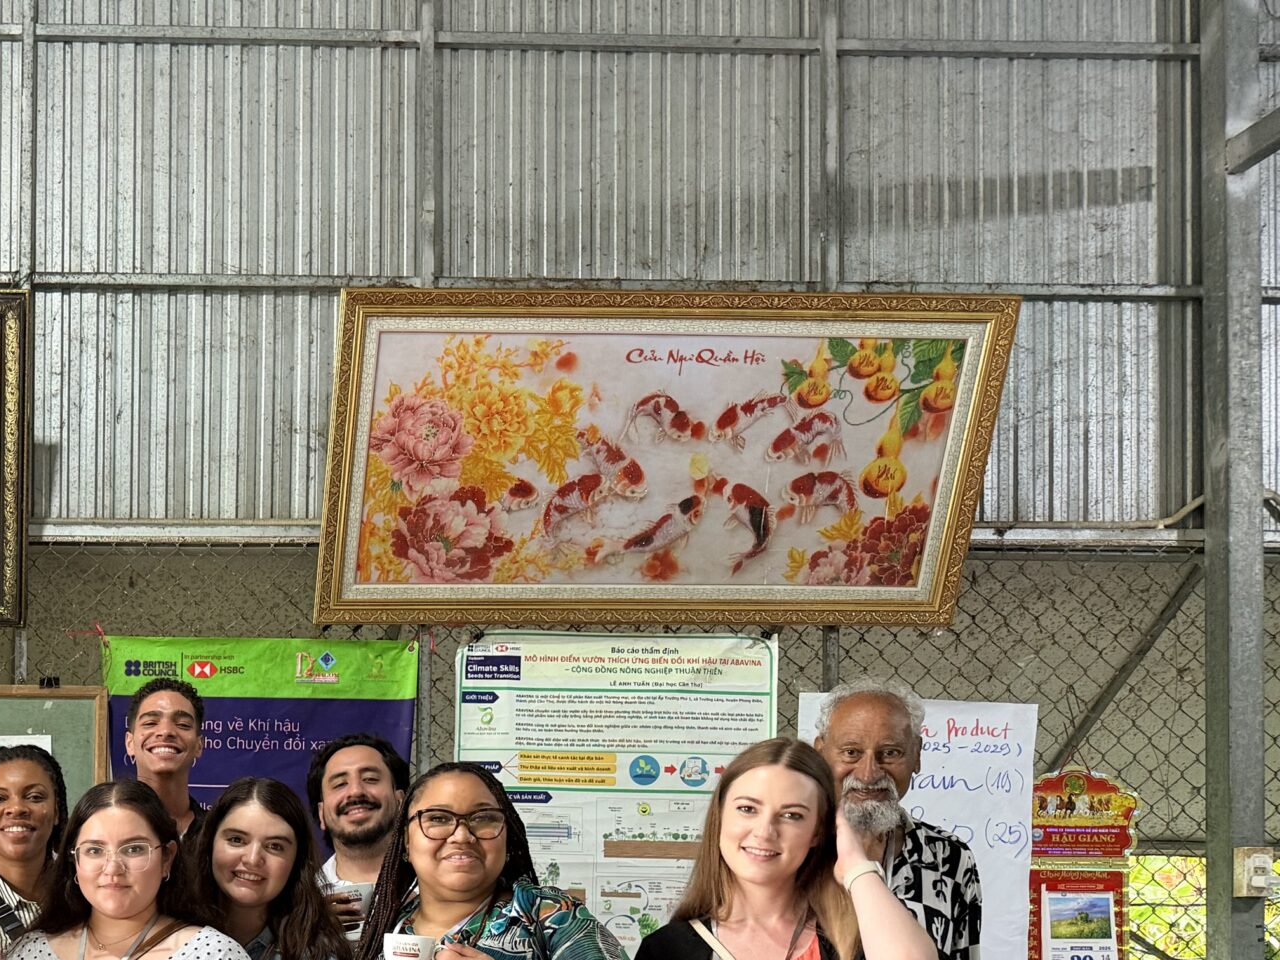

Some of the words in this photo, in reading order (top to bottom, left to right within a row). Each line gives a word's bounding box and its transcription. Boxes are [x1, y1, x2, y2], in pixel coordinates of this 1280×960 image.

[610, 647, 624, 655] Báo
[626, 647, 639, 655] cáo
[662, 648, 679, 656] định
[143, 661, 177, 669] BRITISH
[524, 654, 537, 662] MÔ
[539, 654, 558, 662] HÌNH
[608, 656, 629, 664] THÍCH
[631, 656, 649, 664] ỨNG
[686, 656, 700, 665] KHÍ
[730, 658, 762, 666] ABAVINA
[143, 669, 179, 677] COUNCIL
[219, 666, 245, 675] HSBC
[571, 666, 592, 674] CỘNG
[594, 665, 618, 674] ĐỒNG
[619, 666, 642, 674] NÔNG
[644, 666, 672, 675] NGHIỆP
[227, 716, 244, 731] về
[248, 718, 271, 731] Khí
[274, 718, 300, 733] hậu
[947, 717, 1015, 743] Product
[227, 734, 279, 753] Chuyển
[283, 733, 305, 751] đổi
[1051, 833, 1076, 843] HẬU
[1078, 834, 1115, 843] GIANG
